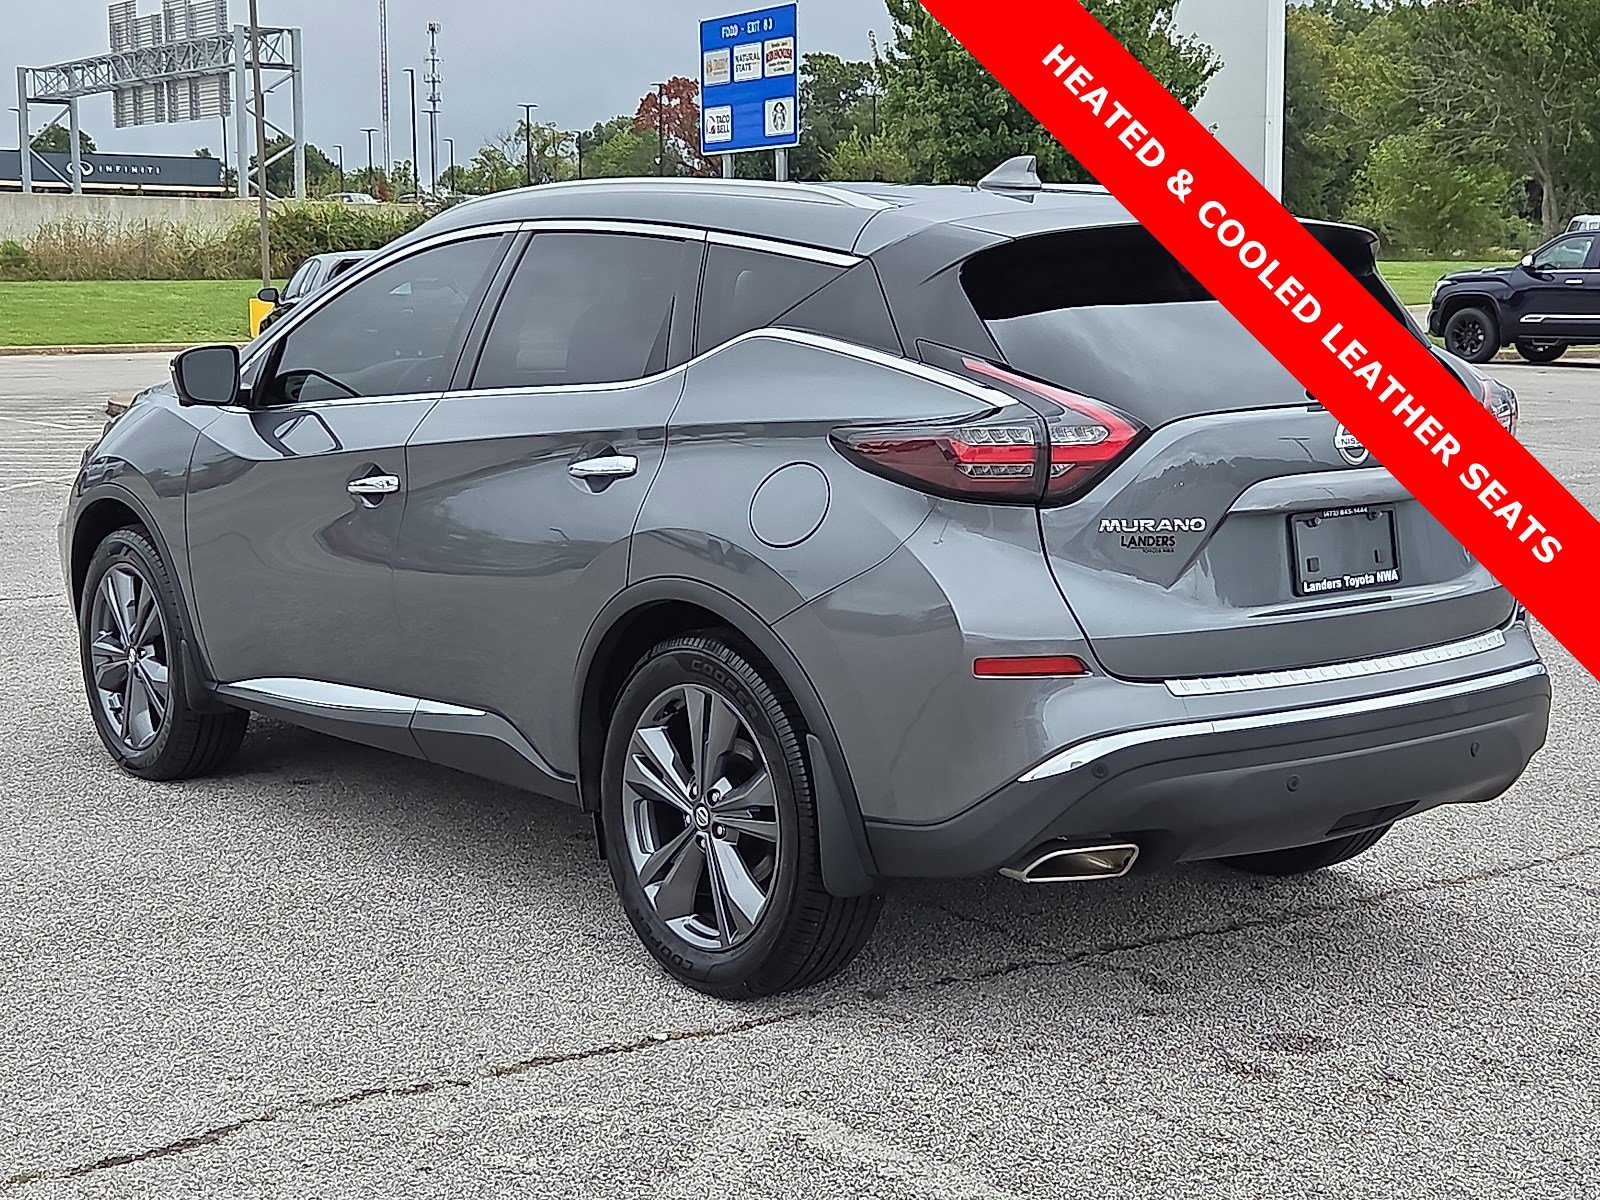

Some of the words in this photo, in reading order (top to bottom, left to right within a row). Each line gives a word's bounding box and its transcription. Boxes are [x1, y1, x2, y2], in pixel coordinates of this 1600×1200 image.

[721, 24, 739, 38] FOOD
[747, 20, 760, 34] EXIT
[735, 52, 760, 63] NATURAL
[735, 62, 752, 73] STATE
[716, 114, 730, 124] TACO
[717, 124, 730, 134] BELL
[98, 164, 162, 175] INFINITI
[1098, 517, 1207, 533] MURANO
[1120, 535, 1176, 549] LANDERS
[1303, 578, 1342, 593] Landers
[1343, 573, 1375, 588] Toyota
[1376, 569, 1399, 582] NWA
